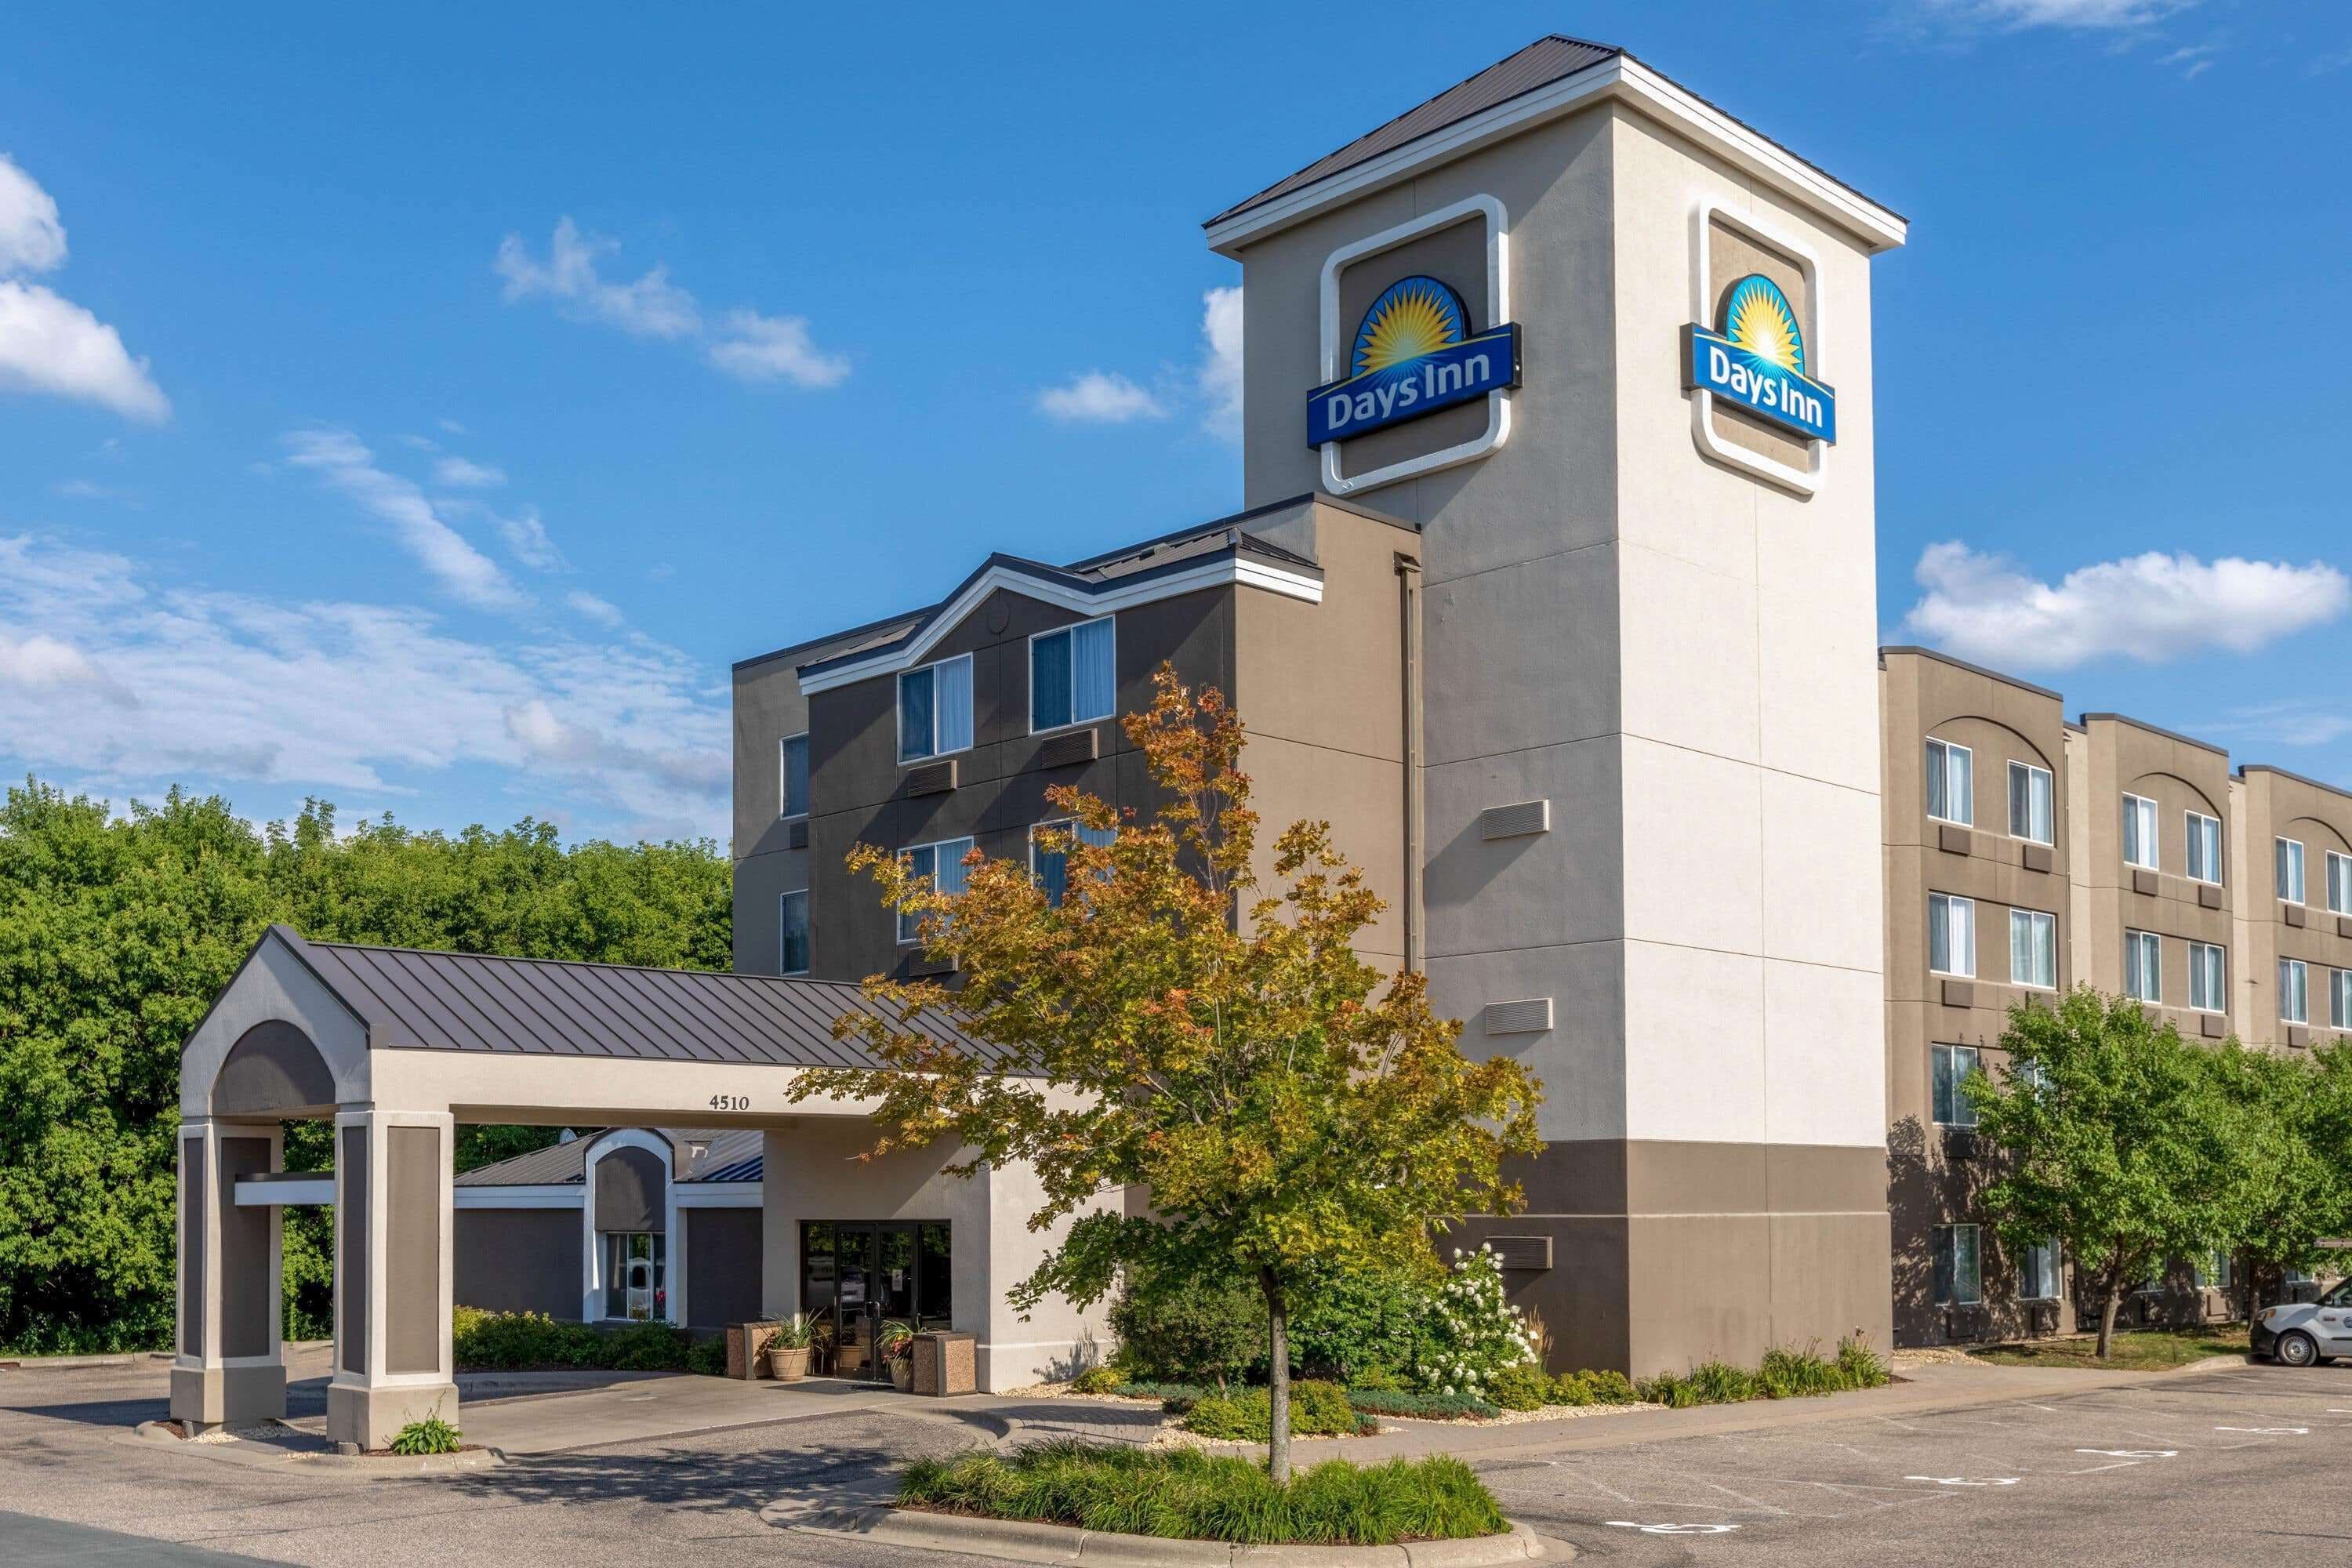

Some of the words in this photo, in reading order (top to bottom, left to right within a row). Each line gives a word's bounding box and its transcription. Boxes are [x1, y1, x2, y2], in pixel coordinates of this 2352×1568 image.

[1328, 377, 1417, 430] Days
[1425, 354, 1490, 398] Inn
[1710, 346, 1777, 406] Days
[1781, 379, 1823, 428] Inn
[709, 1094, 750, 1111] 4510
